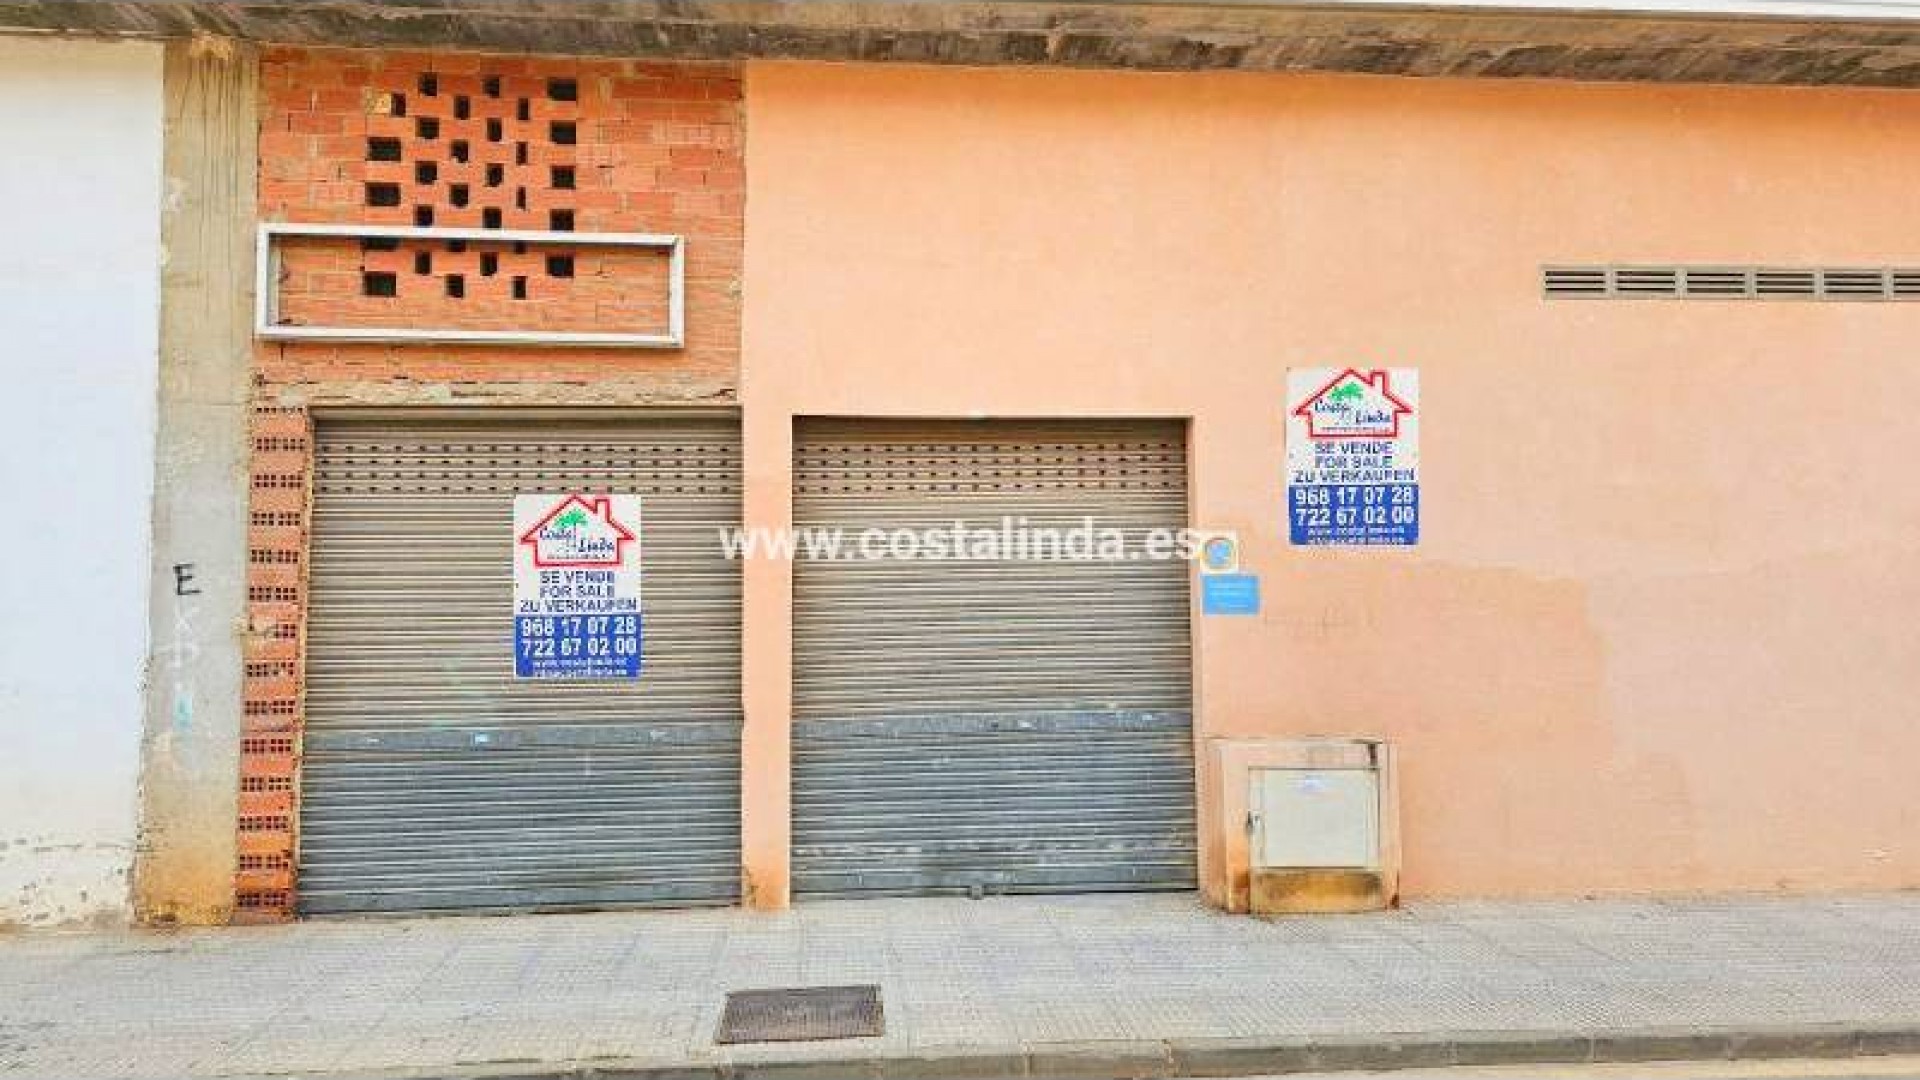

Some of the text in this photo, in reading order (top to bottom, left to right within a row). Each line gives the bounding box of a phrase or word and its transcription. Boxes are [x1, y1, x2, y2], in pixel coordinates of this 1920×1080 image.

[1355, 410, 1391, 424] Linda
[1315, 441, 1393, 454] SE VENDE
[1315, 456, 1393, 468] FOR SALE
[1295, 468, 1415, 483] ZU VERKAUFEN
[1295, 486, 1413, 505] 968 17 07 28
[1295, 506, 1414, 526] 722 67 02 00
[577, 537, 615, 553] Linda
[173, 563, 202, 596] E
[540, 571, 615, 584] SE VENDE
[540, 585, 615, 598] FOR SALE
[520, 598, 637, 613] ZU VERKAUFEN
[521, 616, 637, 637] 968 17 07 28
[521, 637, 637, 656] 722 67 02 00
